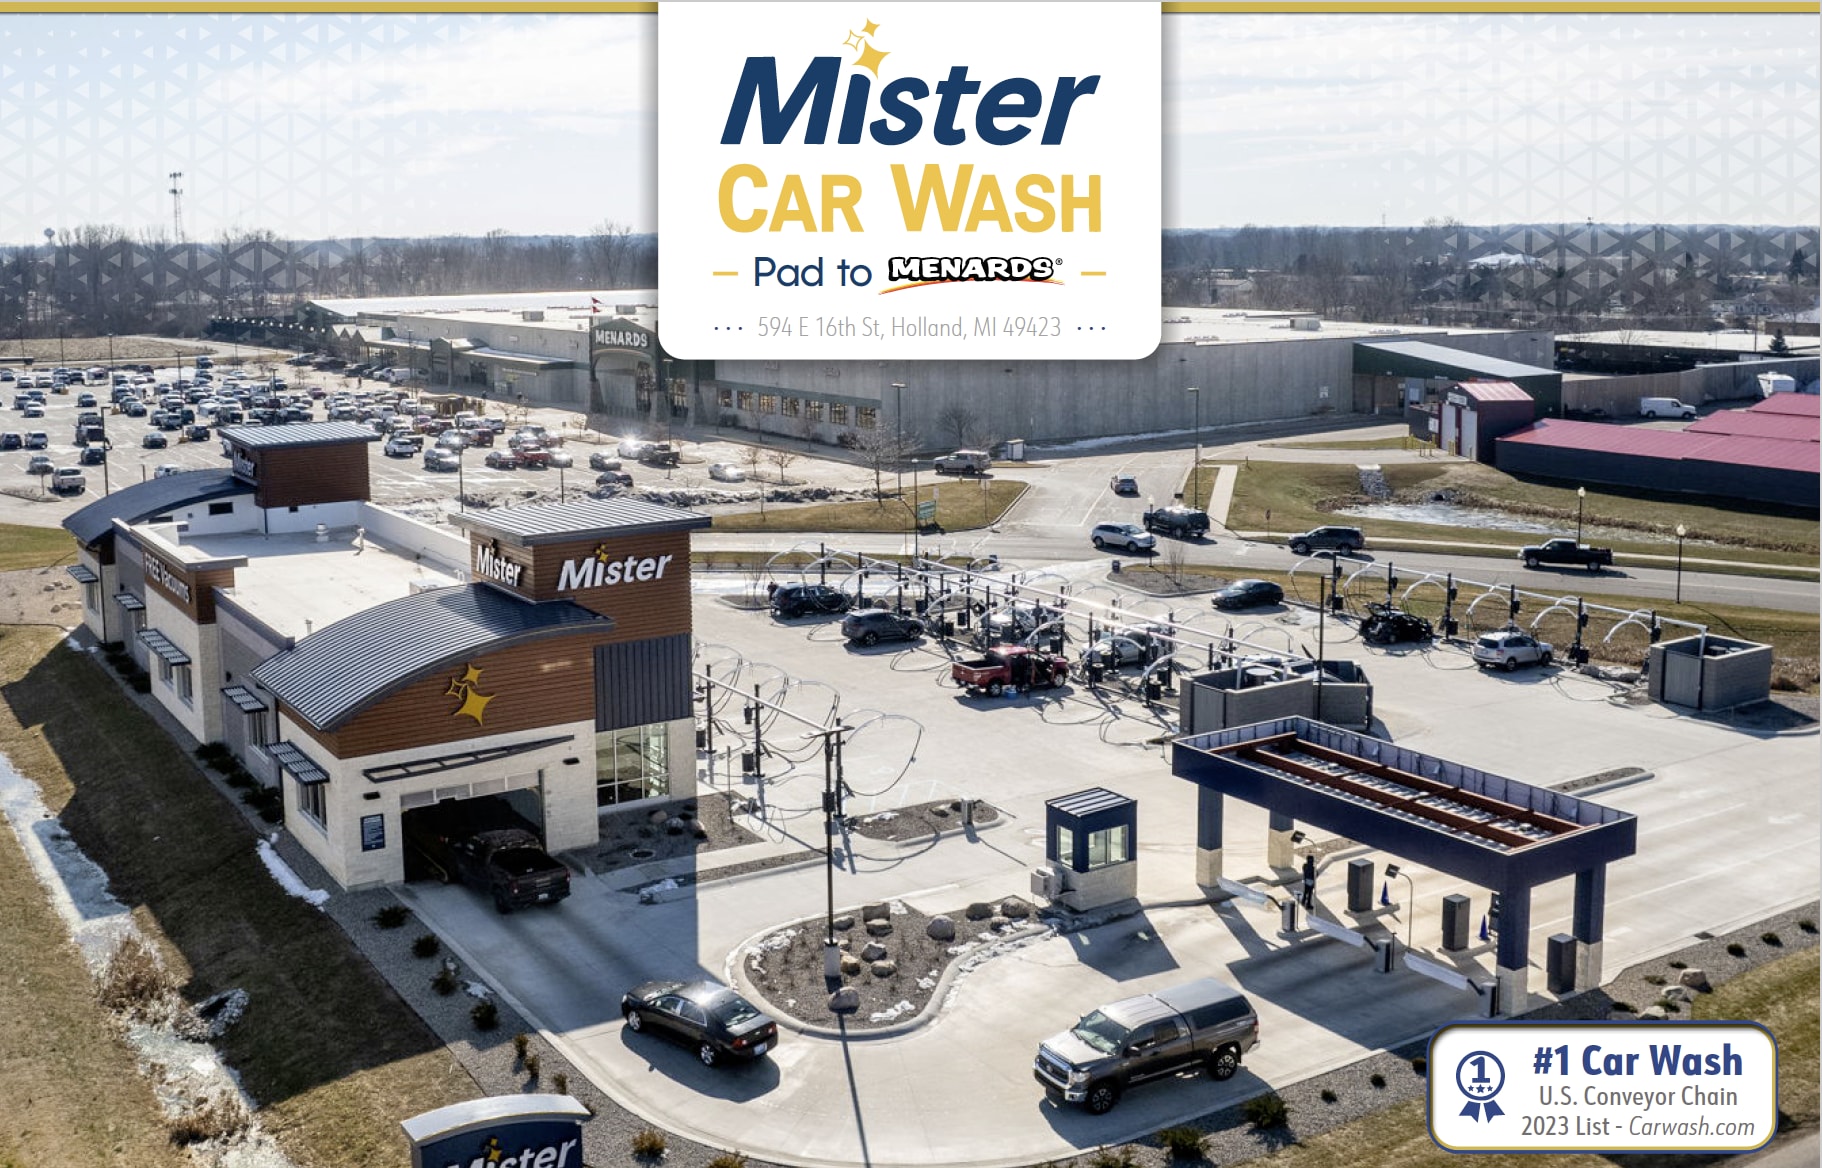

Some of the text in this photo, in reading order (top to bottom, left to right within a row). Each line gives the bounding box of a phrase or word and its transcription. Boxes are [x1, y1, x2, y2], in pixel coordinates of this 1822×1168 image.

[595, 330, 648, 347] MENARDS
[476, 544, 521, 587] Mister
[557, 554, 672, 591] Mister
[447, 1138, 577, 1168] ter
